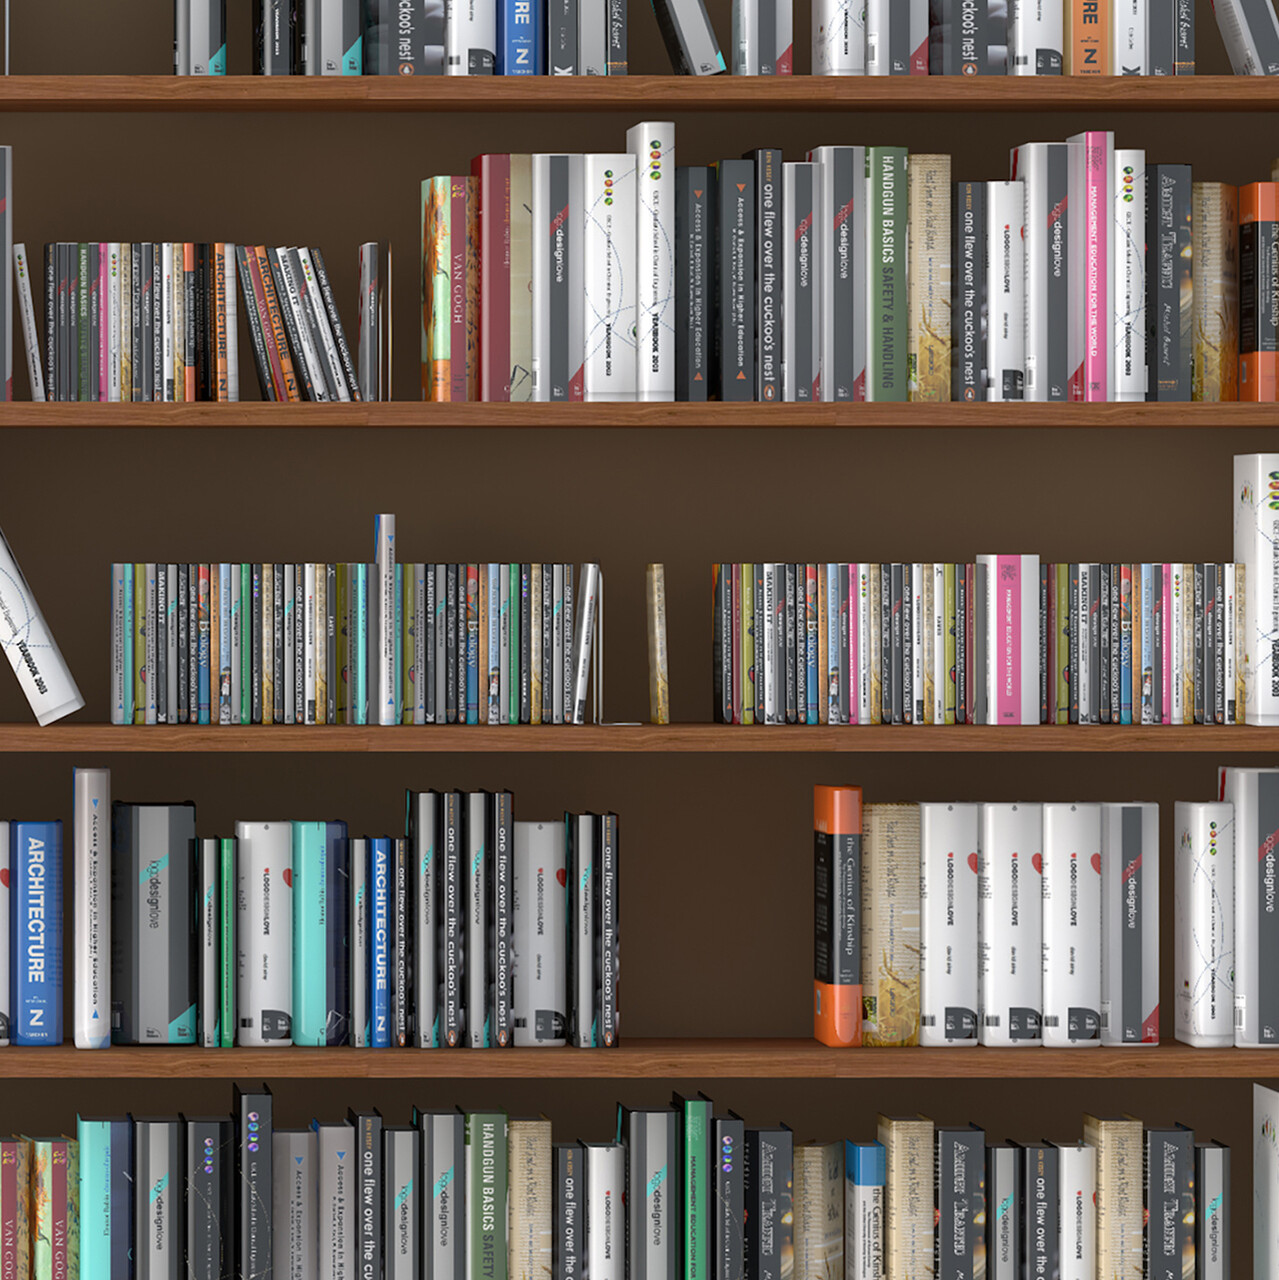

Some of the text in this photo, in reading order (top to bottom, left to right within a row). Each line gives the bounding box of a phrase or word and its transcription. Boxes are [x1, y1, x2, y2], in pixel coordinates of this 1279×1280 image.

[399, 36, 414, 61] nest
[963, 36, 978, 62] nest
[736, 239, 744, 281] Expansion
[882, 156, 894, 388] HANDGUN BASICS SAFETY & HANDLING
[454, 253, 462, 324] VAN GOGH
[764, 184, 775, 381] one flew over the cuckoo's nest
[16, 640, 37, 678] YEARBOOK
[28, 838, 44, 983] ARCHITECTURE
[376, 850, 386, 990] ARCHITECTURE
[364, 1151, 373, 1175] one
[483, 1123, 494, 1183] HANDGUN
[364, 1180, 375, 1204] flew
[483, 1187, 494, 1231] BASICS
[5, 1220, 13, 1248] VAN
[55, 1220, 64, 1248] VAN
[364, 1208, 373, 1236] over
[364, 1240, 375, 1260] the
[483, 1234, 494, 1278] SAFETY
